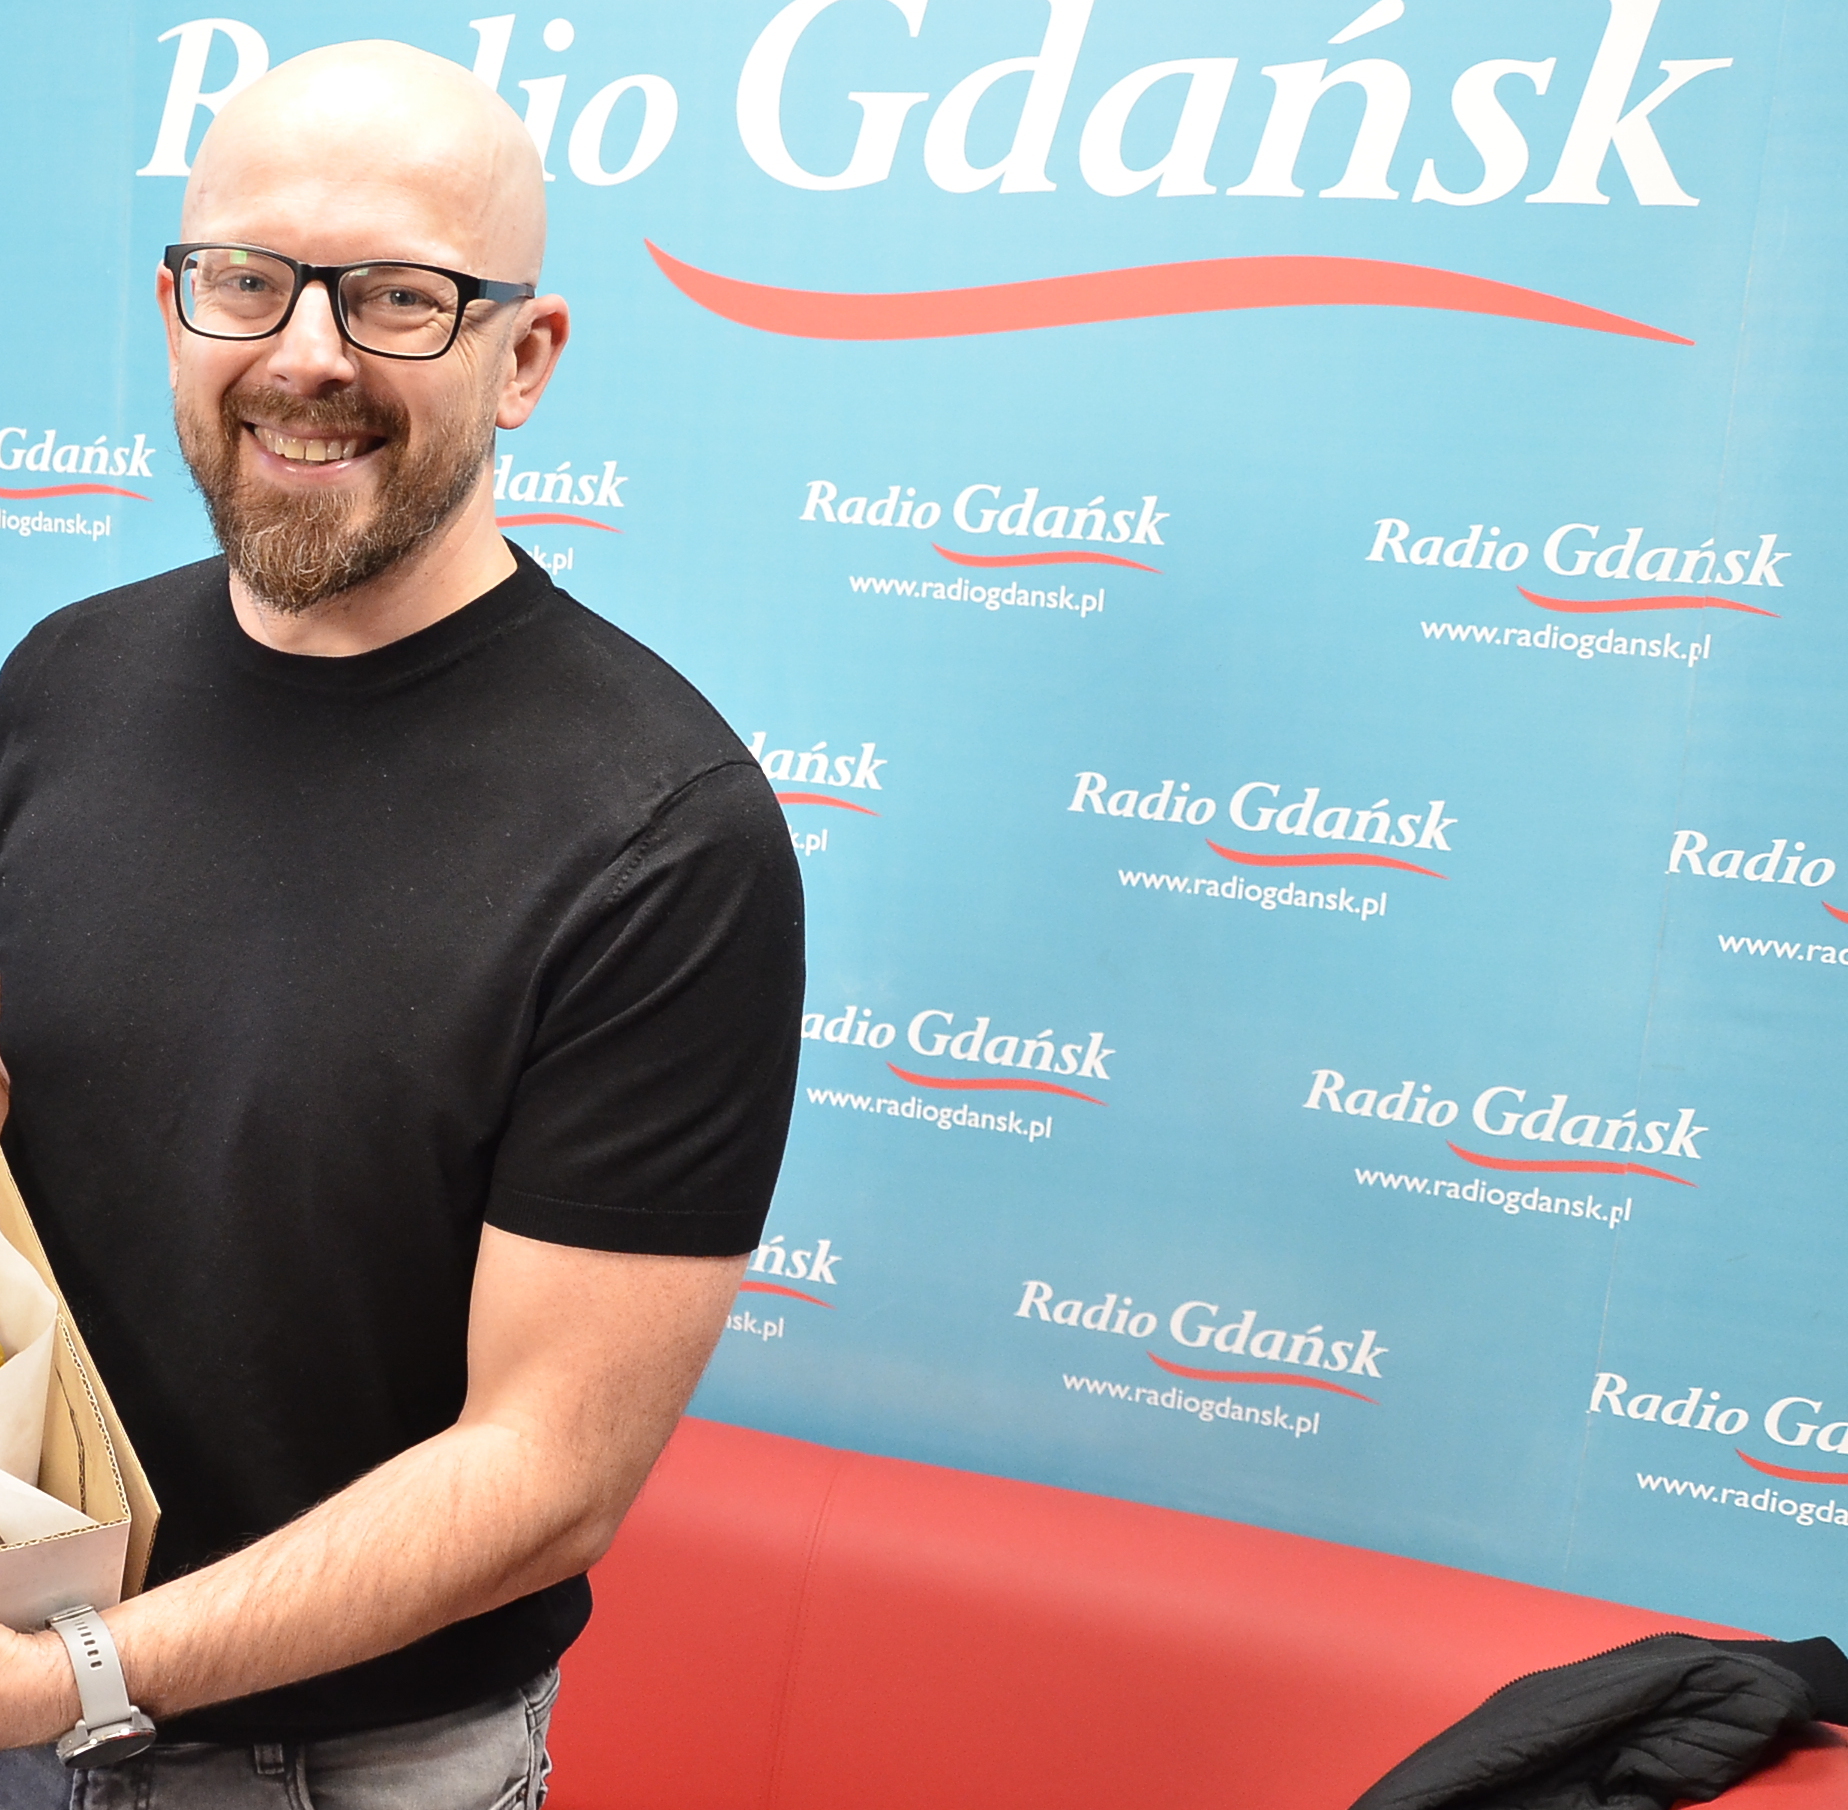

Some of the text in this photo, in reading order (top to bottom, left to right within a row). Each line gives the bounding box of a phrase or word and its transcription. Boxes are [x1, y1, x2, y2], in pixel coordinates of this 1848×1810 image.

[736, 0, 1733, 206] Gdańsk
[800, 480, 1170, 545] Radio Gdańsk
[1365, 518, 1791, 586] Radio Gdańsk
[850, 576, 1104, 617] www.radiogdansk.pl
[1421, 613, 1711, 667] www.radiogdansk.pl
[1068, 772, 1458, 851] Radio Gdańsk
[1665, 830, 1835, 886] Radio
[1119, 866, 1386, 921] www.radiogdansk.pl
[908, 1010, 1115, 1079] Gdańsk
[807, 1088, 1052, 1142] www.radiogdansk.pl
[1303, 1069, 1708, 1158] Radio Gdańsk
[1355, 1169, 1632, 1229] www.radiogdansk.pl
[1015, 1281, 1388, 1377] Radio Gdańsk
[1063, 1374, 1319, 1438] www.radiogdansk.pl
[1586, 1373, 1749, 1434] Radio
